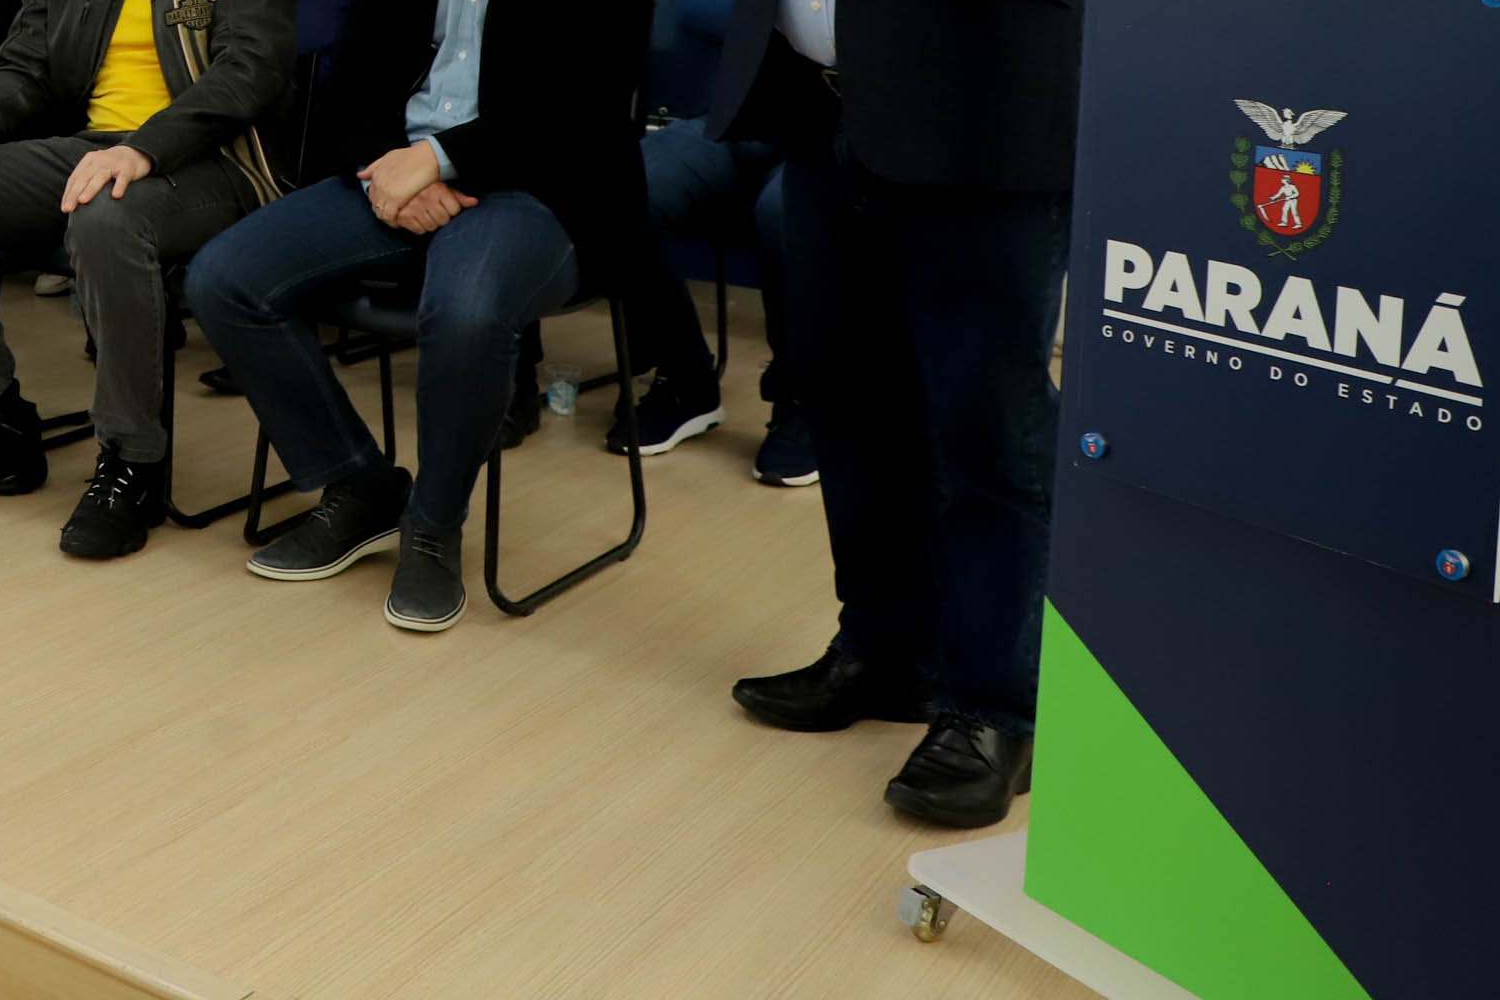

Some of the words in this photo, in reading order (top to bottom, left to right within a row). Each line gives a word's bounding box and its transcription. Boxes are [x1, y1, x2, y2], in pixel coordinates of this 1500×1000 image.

[1101, 324, 1243, 371] GOVERNO
[1270, 366, 1309, 387] DO
[1338, 382, 1483, 431] ESTADO
[1102, 239, 1484, 388] PARANÁ
